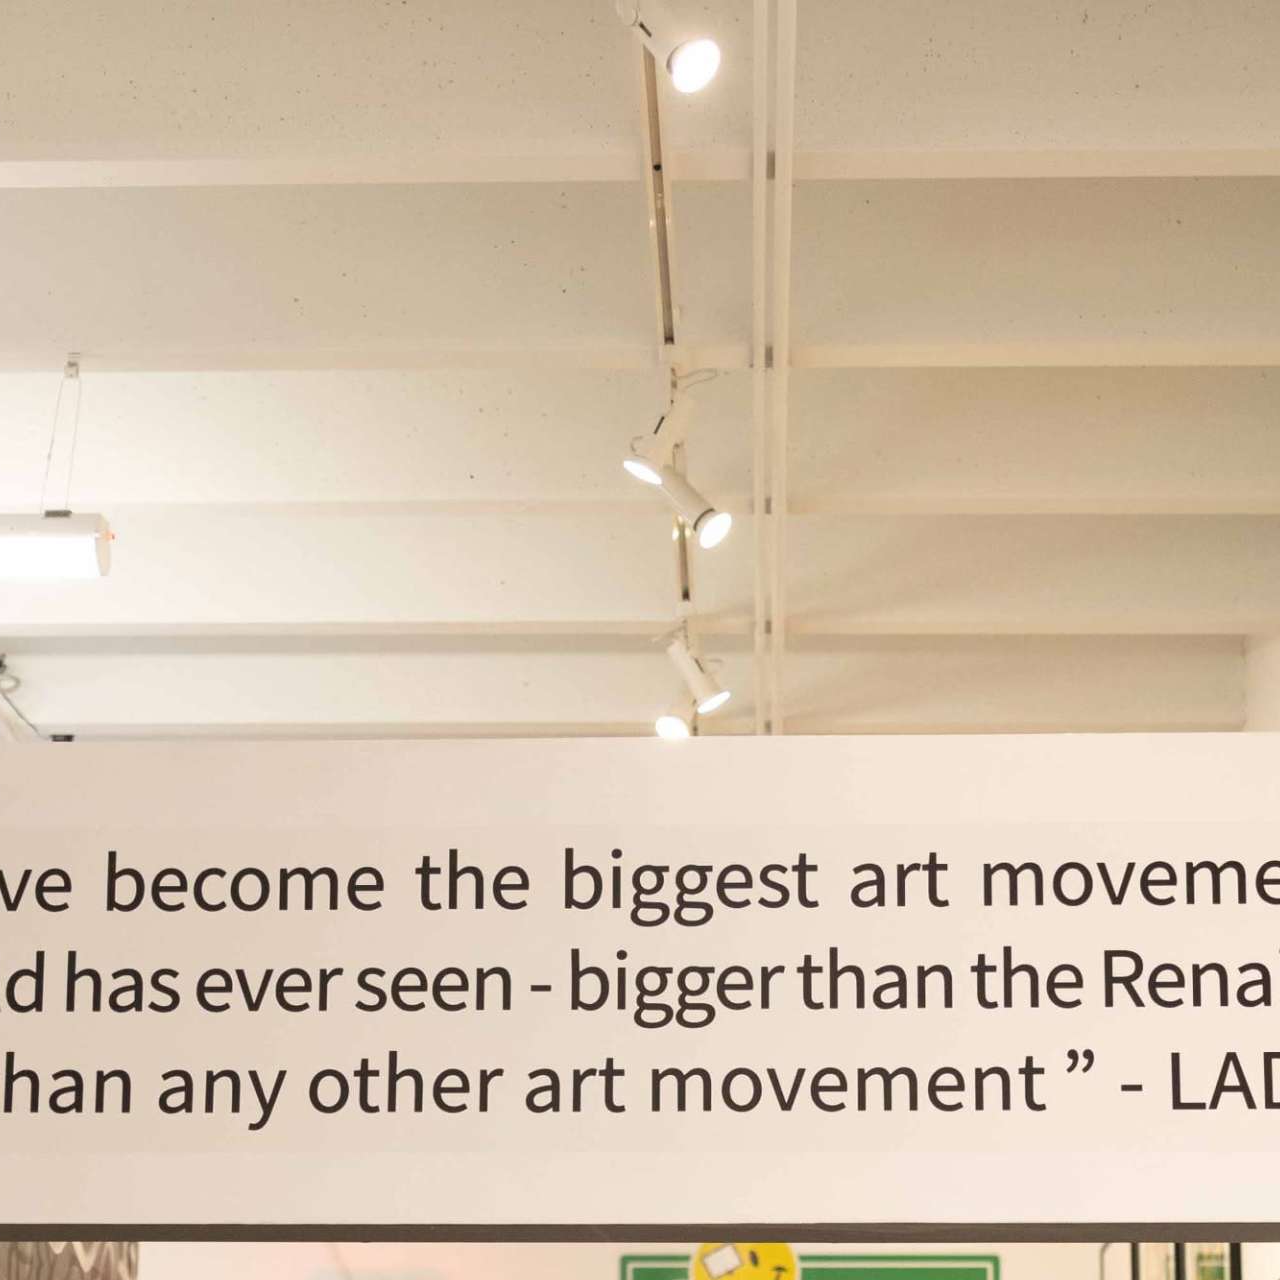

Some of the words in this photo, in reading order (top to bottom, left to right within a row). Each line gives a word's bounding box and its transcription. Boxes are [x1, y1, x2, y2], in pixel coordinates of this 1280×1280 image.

[107, 851, 384, 912] become
[415, 849, 529, 910] the
[565, 848, 818, 927] biggest
[851, 853, 949, 907] art
[66, 951, 180, 1013] has
[197, 968, 343, 1012] ever
[356, 967, 511, 1011] seen
[571, 949, 785, 1028] bigger
[797, 947, 952, 1009] than
[971, 946, 1083, 1008] the
[159, 1070, 287, 1130] any
[309, 1051, 504, 1113] other
[526, 1058, 625, 1113] art
[652, 1056, 1046, 1112] movement
